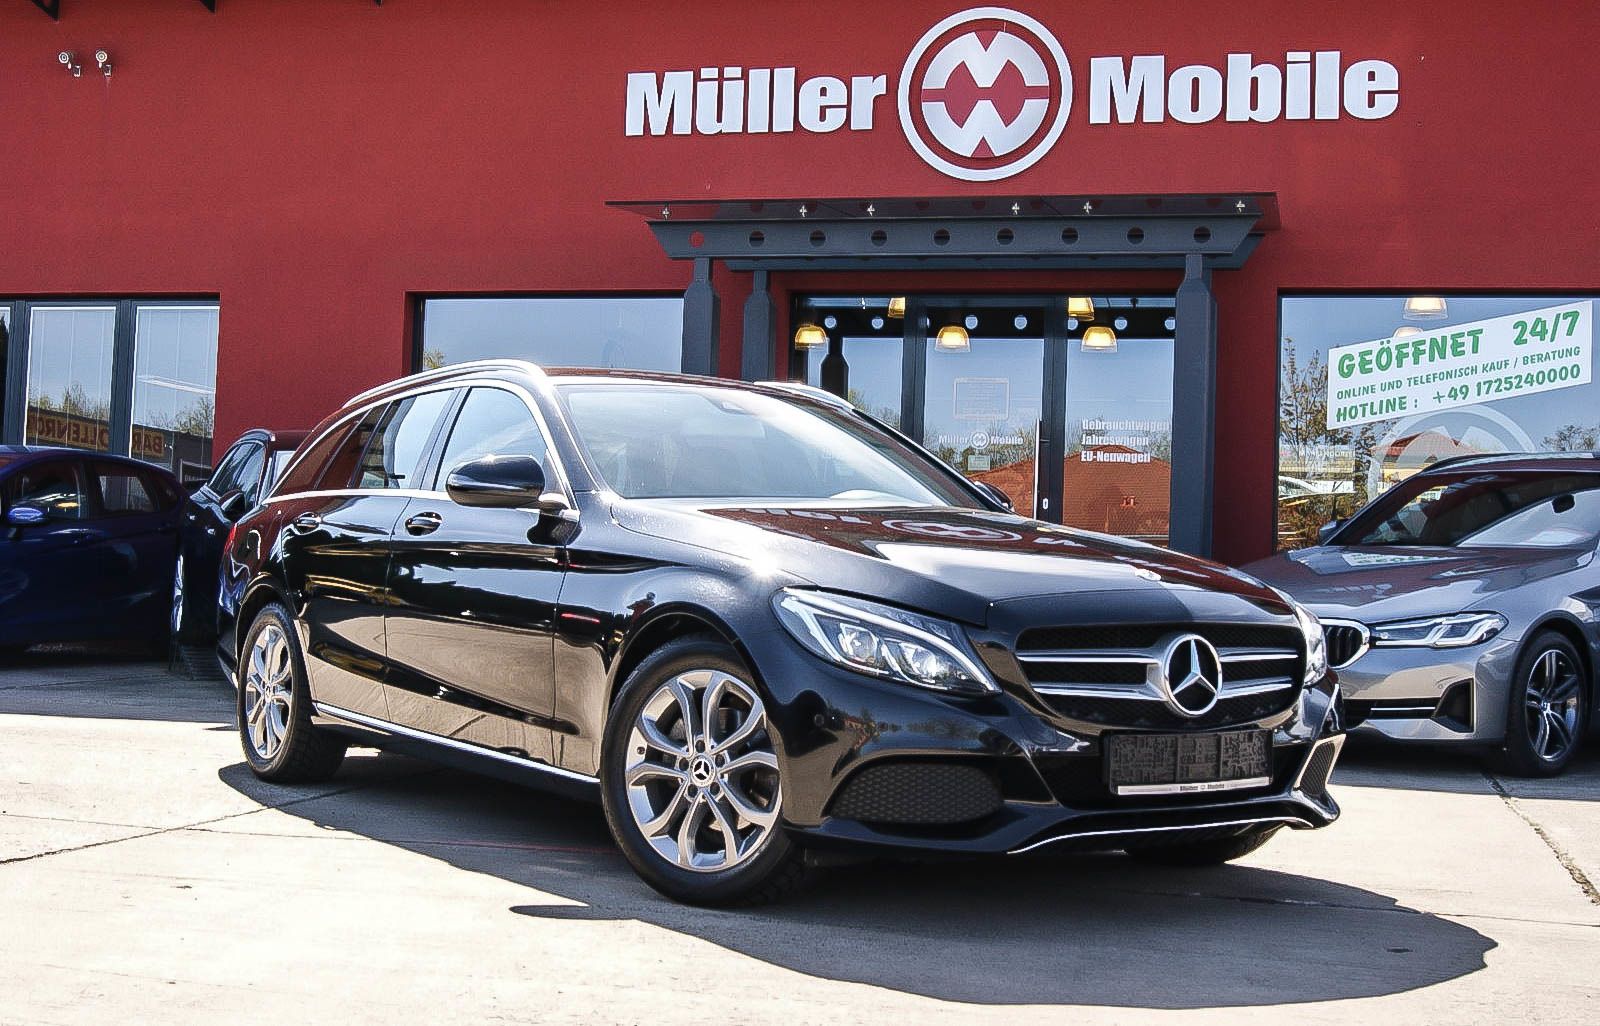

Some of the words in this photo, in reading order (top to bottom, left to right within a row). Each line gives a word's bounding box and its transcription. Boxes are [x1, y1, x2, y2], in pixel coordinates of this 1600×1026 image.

[625, 68, 887, 137] Müller
[1089, 51, 1400, 125] Mobile
[1336, 384, 1376, 400] ONLINE
[1380, 379, 1402, 393] UND
[1407, 365, 1478, 388] TELEFONISCH
[1482, 358, 1510, 374] KAUF
[1522, 345, 1580, 366] BERATUNG
[1338, 328, 1483, 379] GEÖFFNET
[1513, 310, 1580, 346] 24/7
[1336, 396, 1407, 422] HOTLINE
[1432, 384, 1469, 404] +49
[1477, 364, 1580, 398] 1725240000
